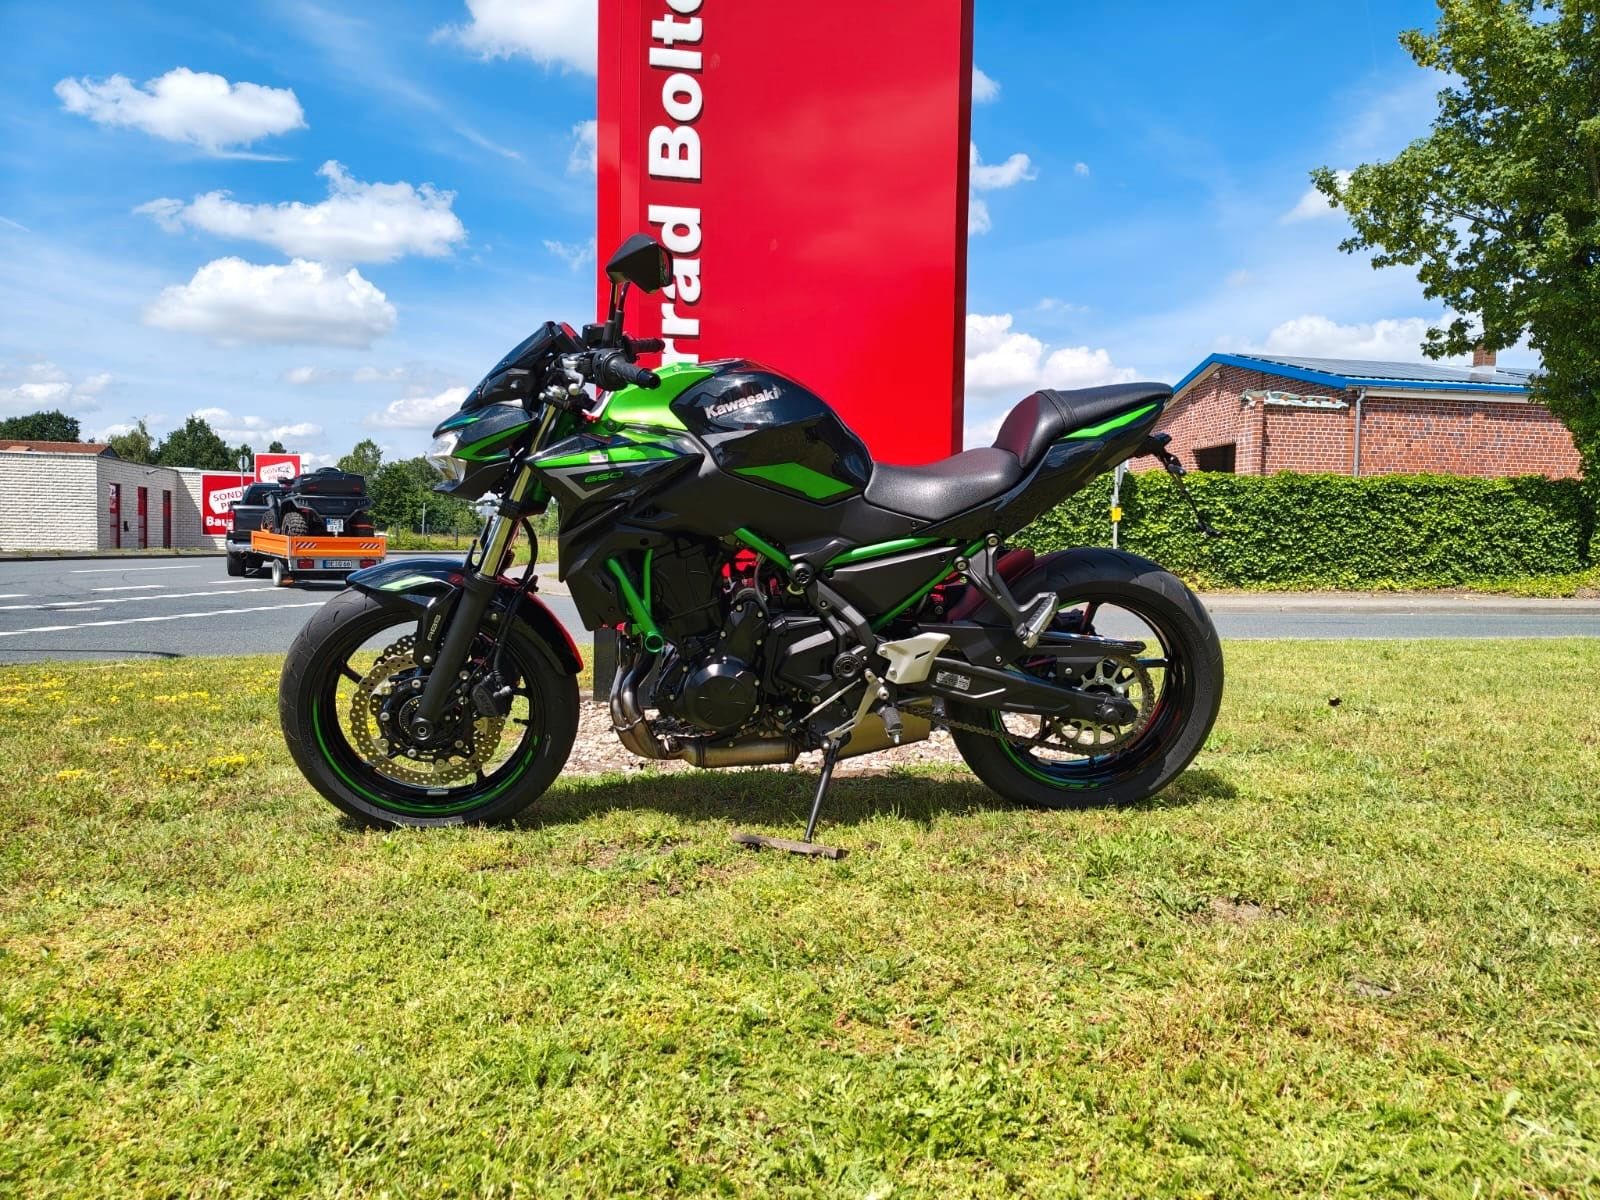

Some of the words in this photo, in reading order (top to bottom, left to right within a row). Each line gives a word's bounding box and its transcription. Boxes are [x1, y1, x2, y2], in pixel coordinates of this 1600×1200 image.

[649, 0, 702, 179] Bolt
[704, 387, 779, 419] Kawasaki
[584, 471, 624, 483] 650
[427, 614, 441, 641] ABS
